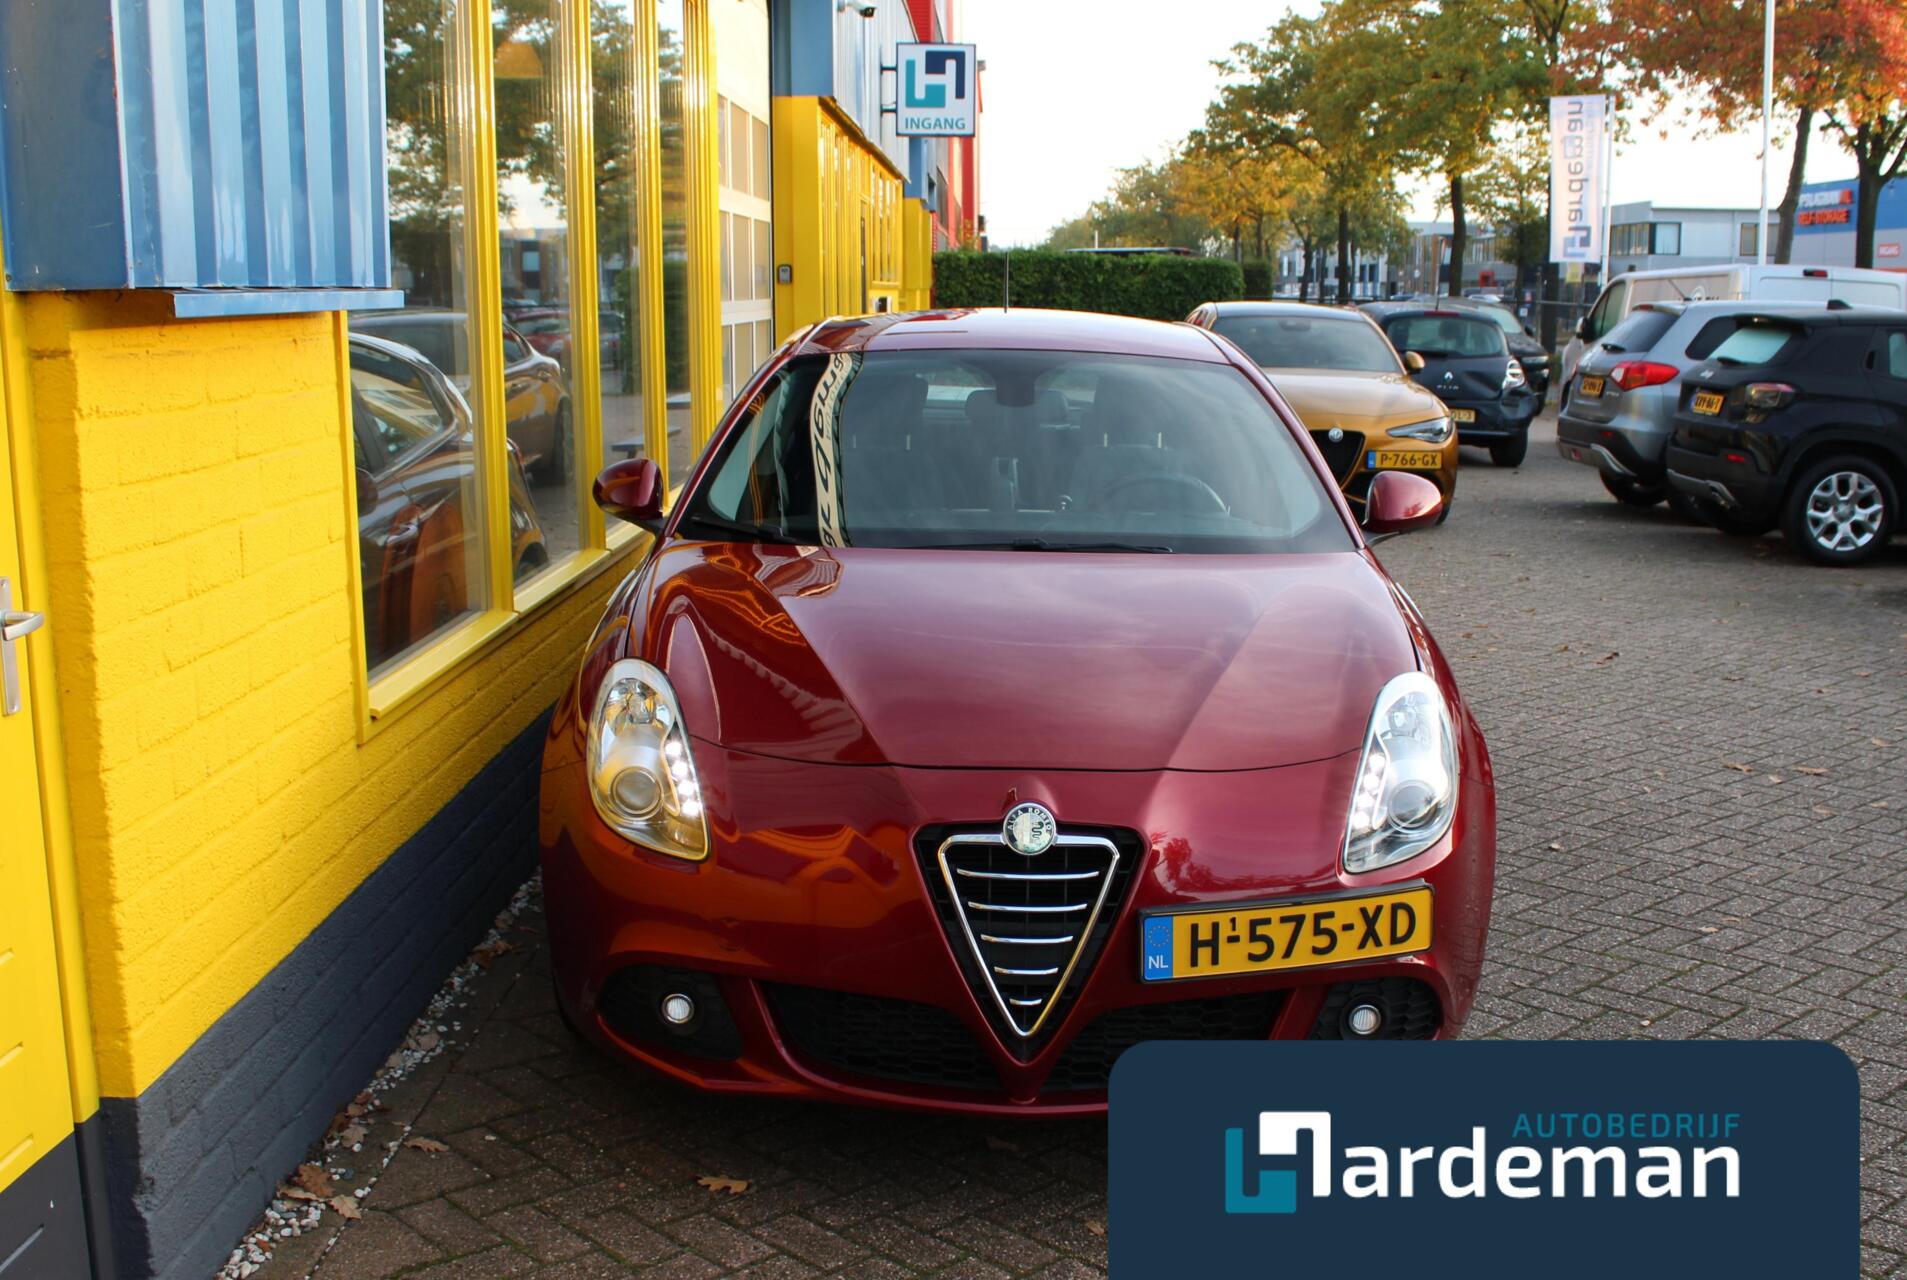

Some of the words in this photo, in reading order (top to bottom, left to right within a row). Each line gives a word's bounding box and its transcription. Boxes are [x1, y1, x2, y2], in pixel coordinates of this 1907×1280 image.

[905, 117, 966, 130] INGANG
[1380, 453, 1438, 466] P-766-GX
[1148, 955, 1168, 969] NL
